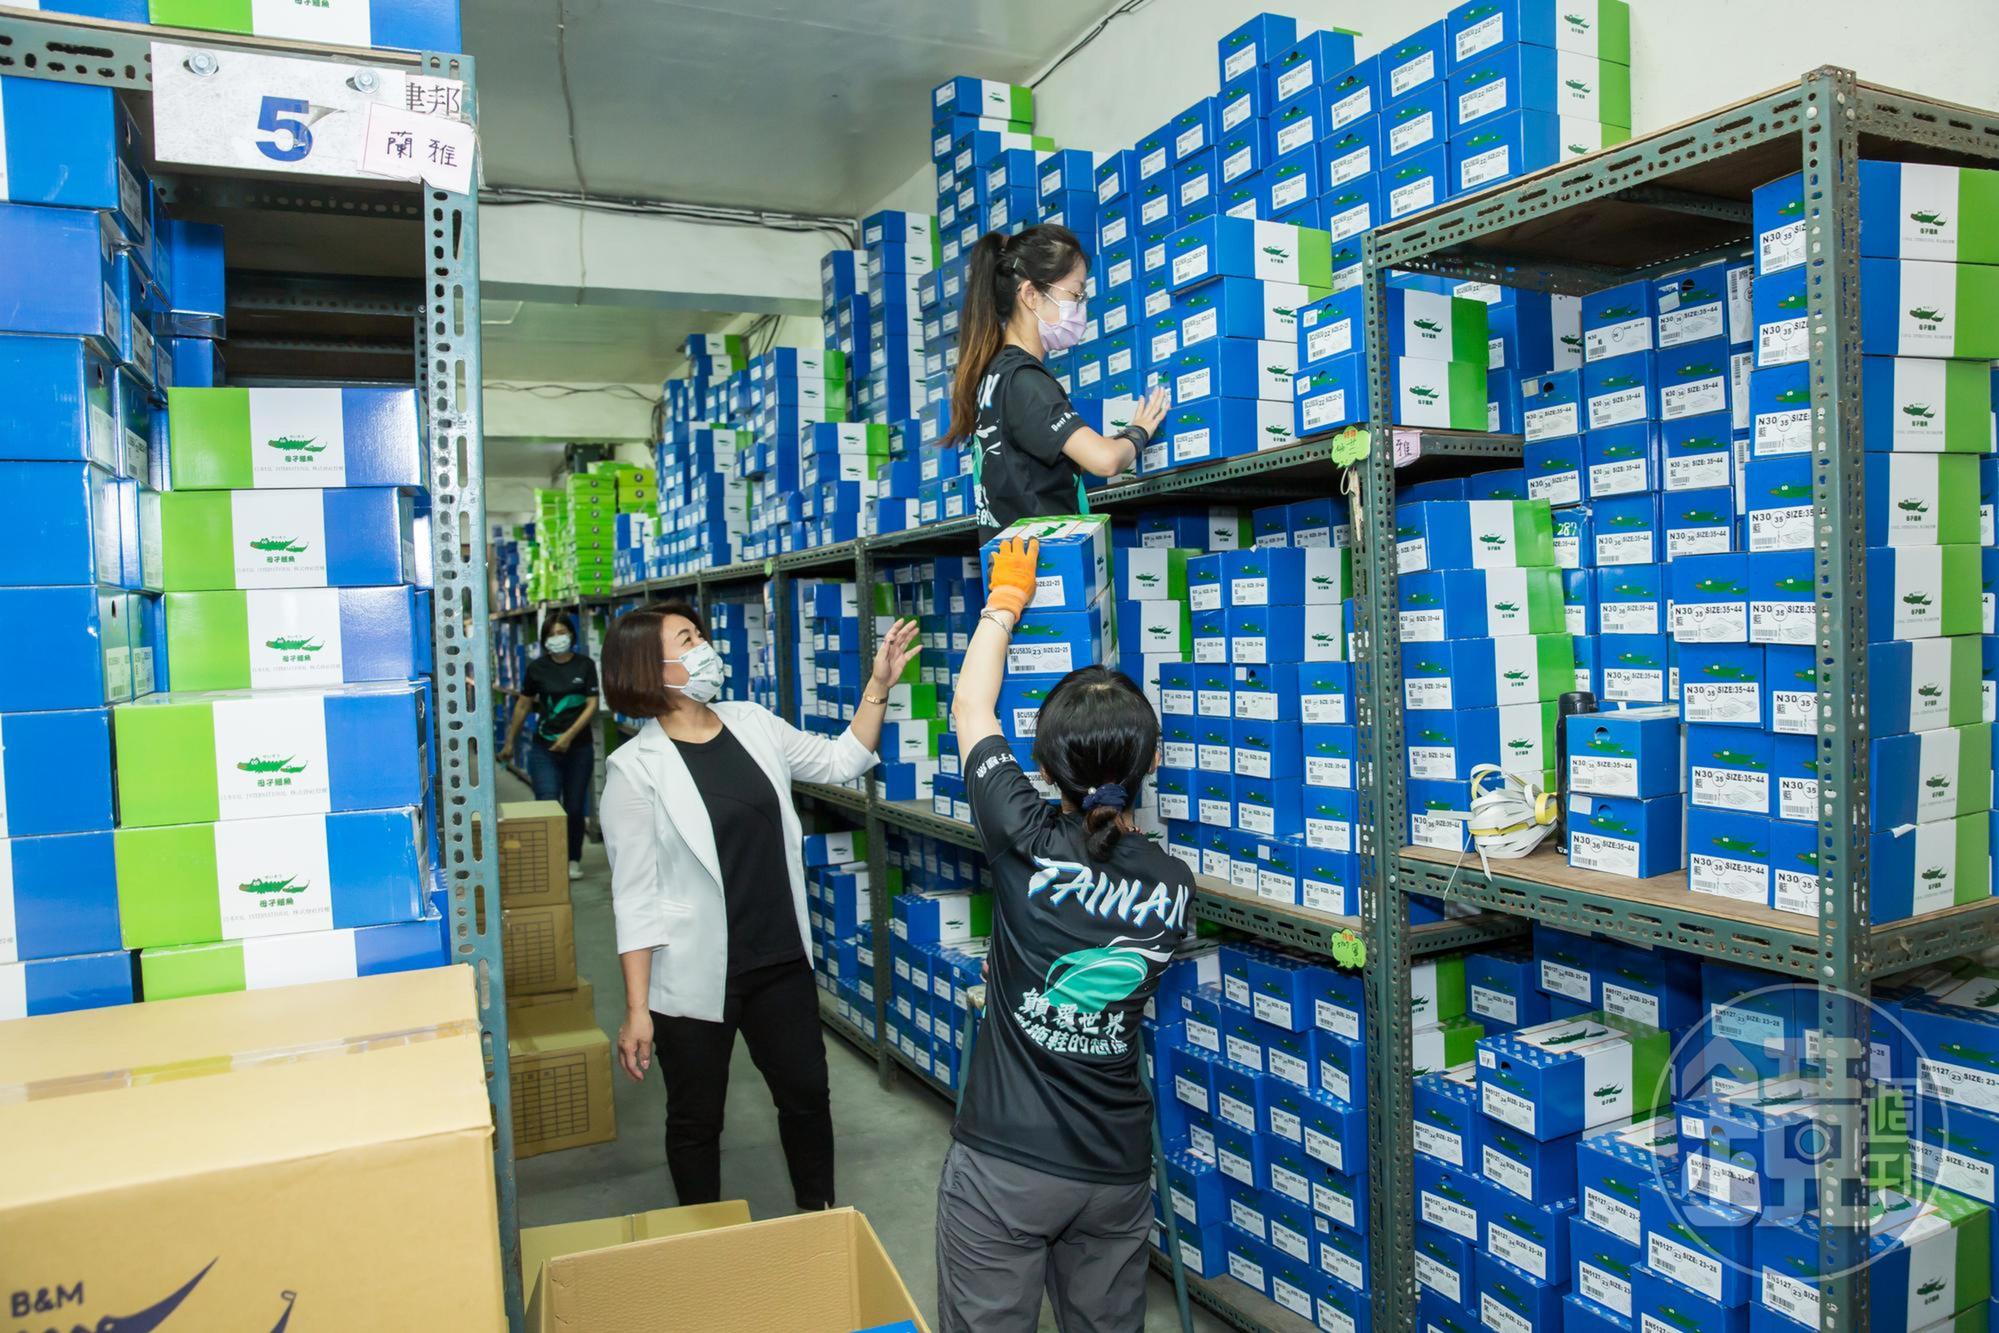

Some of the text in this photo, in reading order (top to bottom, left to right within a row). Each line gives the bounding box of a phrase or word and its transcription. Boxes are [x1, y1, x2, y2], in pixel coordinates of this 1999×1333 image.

[255, 95, 313, 162] 5
[1763, 232, 1781, 243] N30
[1660, 316, 1674, 325] N30
[1762, 325, 1781, 336] N30
[1665, 389, 1676, 397] N30
[1758, 416, 1777, 426] N30
[1530, 481, 1543, 489] N30
[1752, 513, 1771, 523] N30
[1598, 537, 1613, 545] N30
[1669, 532, 1685, 541] N30
[1675, 607, 1692, 615] N30
[1753, 605, 1772, 613] N30
[1687, 686, 1704, 694] N30
[1776, 695, 1797, 703] N30
[1694, 770, 1713, 778] N30
[1782, 781, 1803, 790] N30
[1573, 835, 1590, 843] N30
[1693, 858, 1711, 866] N30
[1778, 873, 1798, 884] N30
[1027, 854, 1190, 931] TAIWAN
[1920, 1063, 1949, 1076] BN5127
[1587, 1192, 1606, 1205] BN5127
[1652, 1237, 1673, 1252] BN5127
[1767, 1272, 1791, 1290] BN5127
[10, 1282, 84, 1318] B&M
